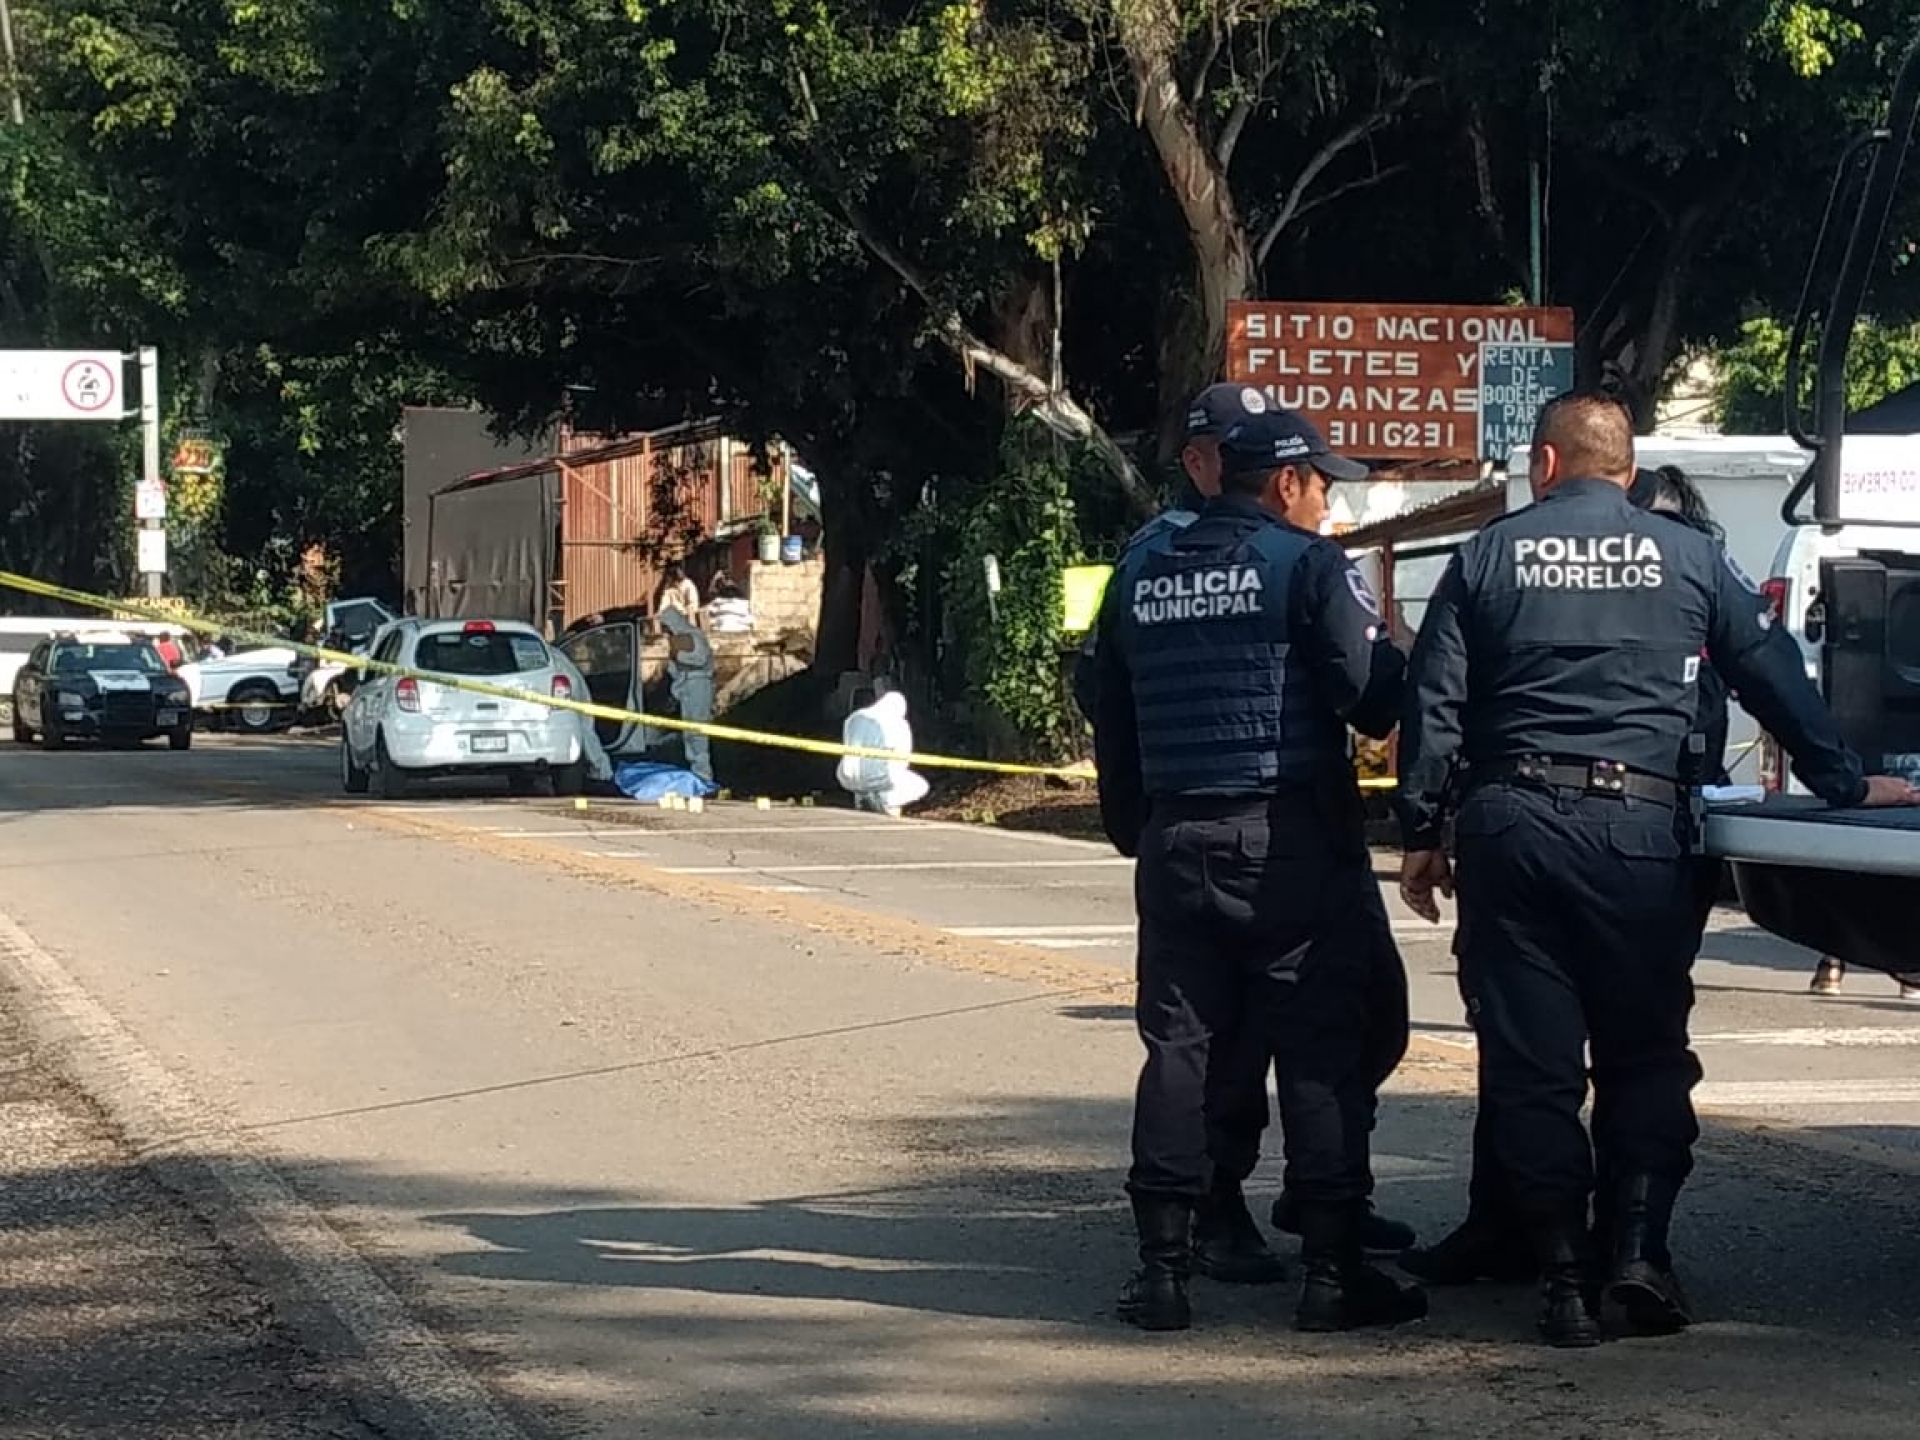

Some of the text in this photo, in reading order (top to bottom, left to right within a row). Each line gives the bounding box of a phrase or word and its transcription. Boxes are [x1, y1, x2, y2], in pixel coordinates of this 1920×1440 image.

[1246, 314, 1546, 342] SITIO NACIONAL
[1248, 347, 1476, 378] FLETES Y
[1484, 347, 1555, 366] RENTA
[1511, 366, 1541, 388] DE
[1265, 384, 1478, 412] UDANZAS
[1503, 405, 1537, 424] PAR
[1514, 533, 1662, 563] POLICÍA
[1134, 565, 1263, 602] POLICÍA
[1515, 564, 1663, 589] MORELOS
[1133, 592, 1264, 624] MUNICIPAL
